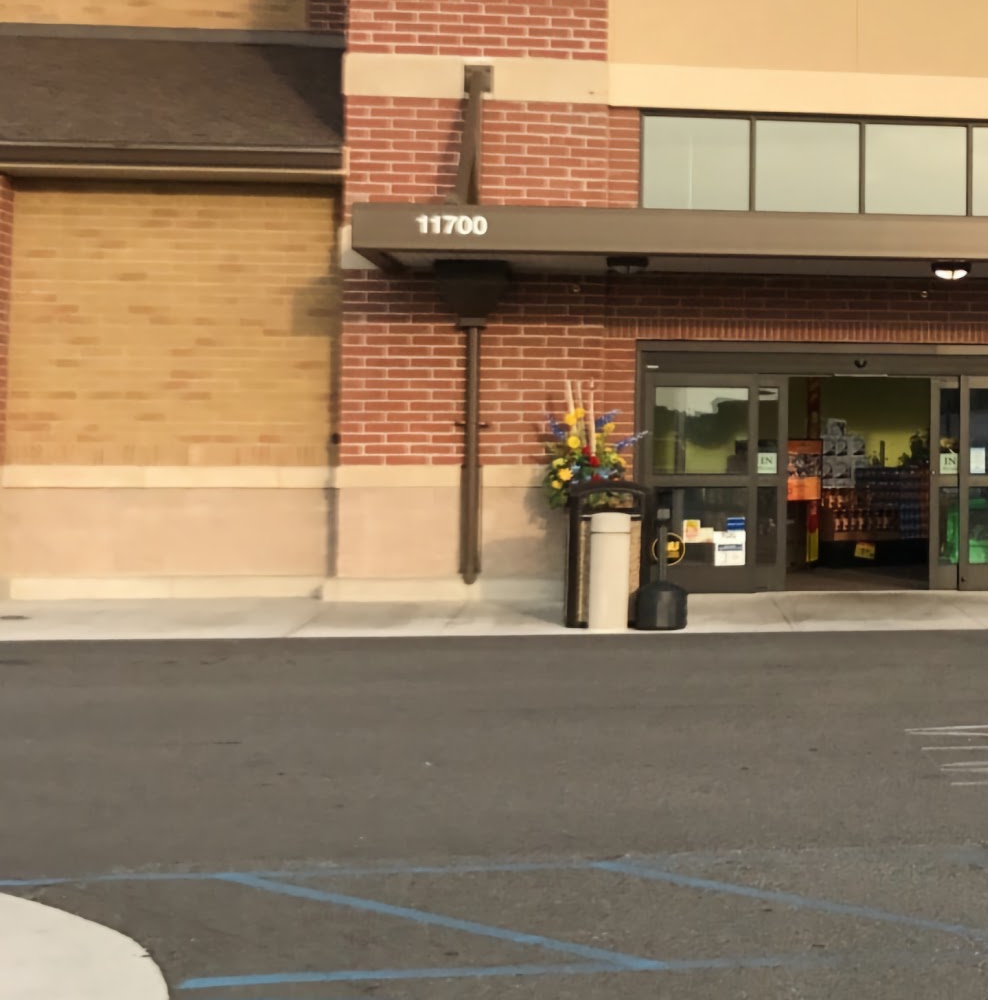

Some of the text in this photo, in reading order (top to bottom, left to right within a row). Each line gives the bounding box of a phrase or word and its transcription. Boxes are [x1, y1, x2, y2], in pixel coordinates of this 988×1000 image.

[416, 214, 488, 235] 11700
[760, 456, 773, 465] IN
[943, 457, 957, 466] IN
